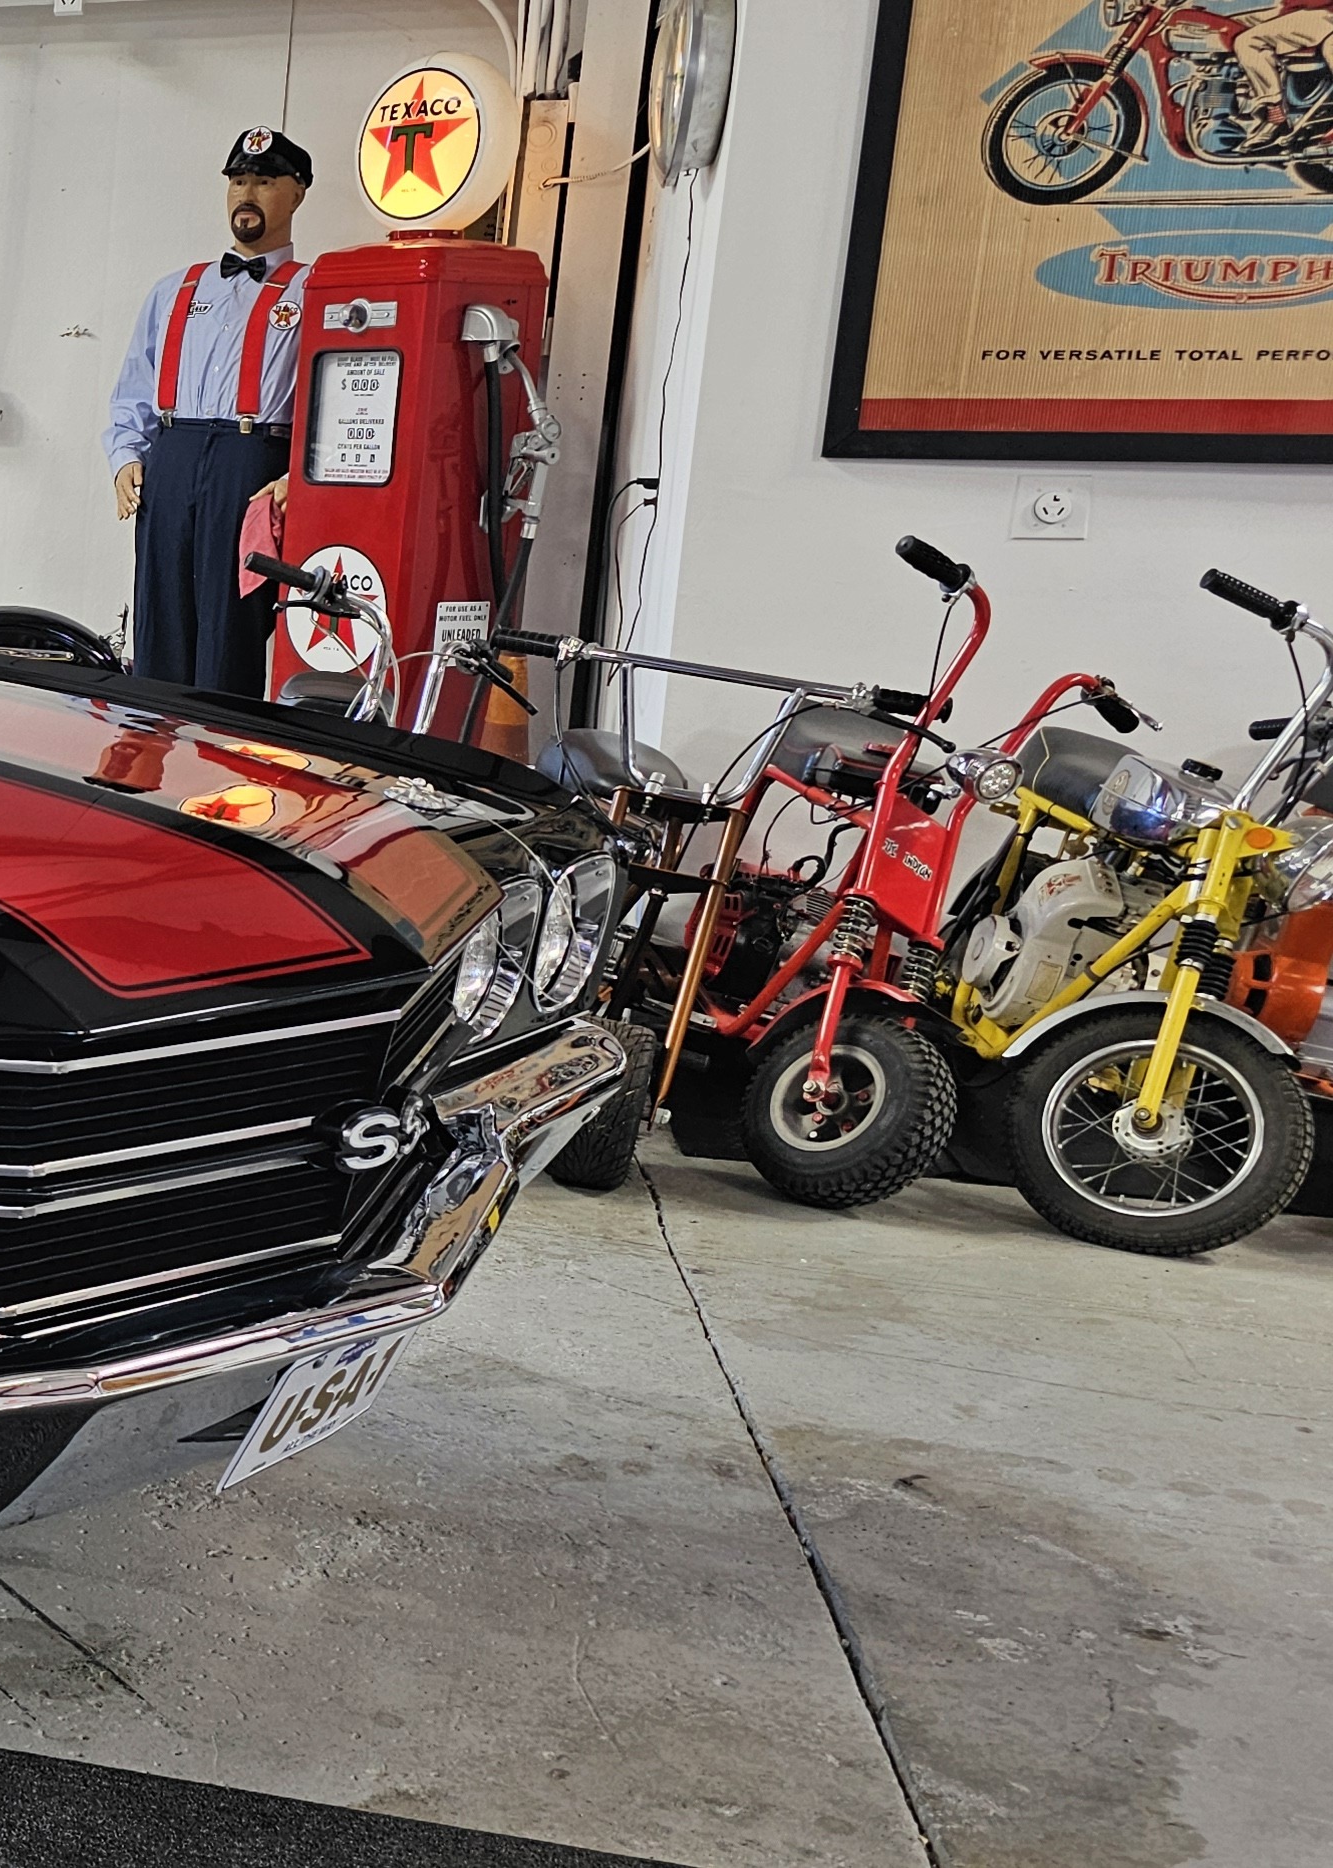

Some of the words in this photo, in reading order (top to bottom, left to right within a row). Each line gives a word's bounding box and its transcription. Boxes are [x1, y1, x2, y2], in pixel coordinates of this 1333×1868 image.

[379, 97, 462, 122] TEXACO
[1094, 247, 1333, 284] TRIUMPH
[981, 349, 1027, 361] FOR
[1040, 349, 1162, 361] VERSATILE
[1175, 349, 1244, 361] TOTAL
[441, 628, 481, 642] UNLEADED
